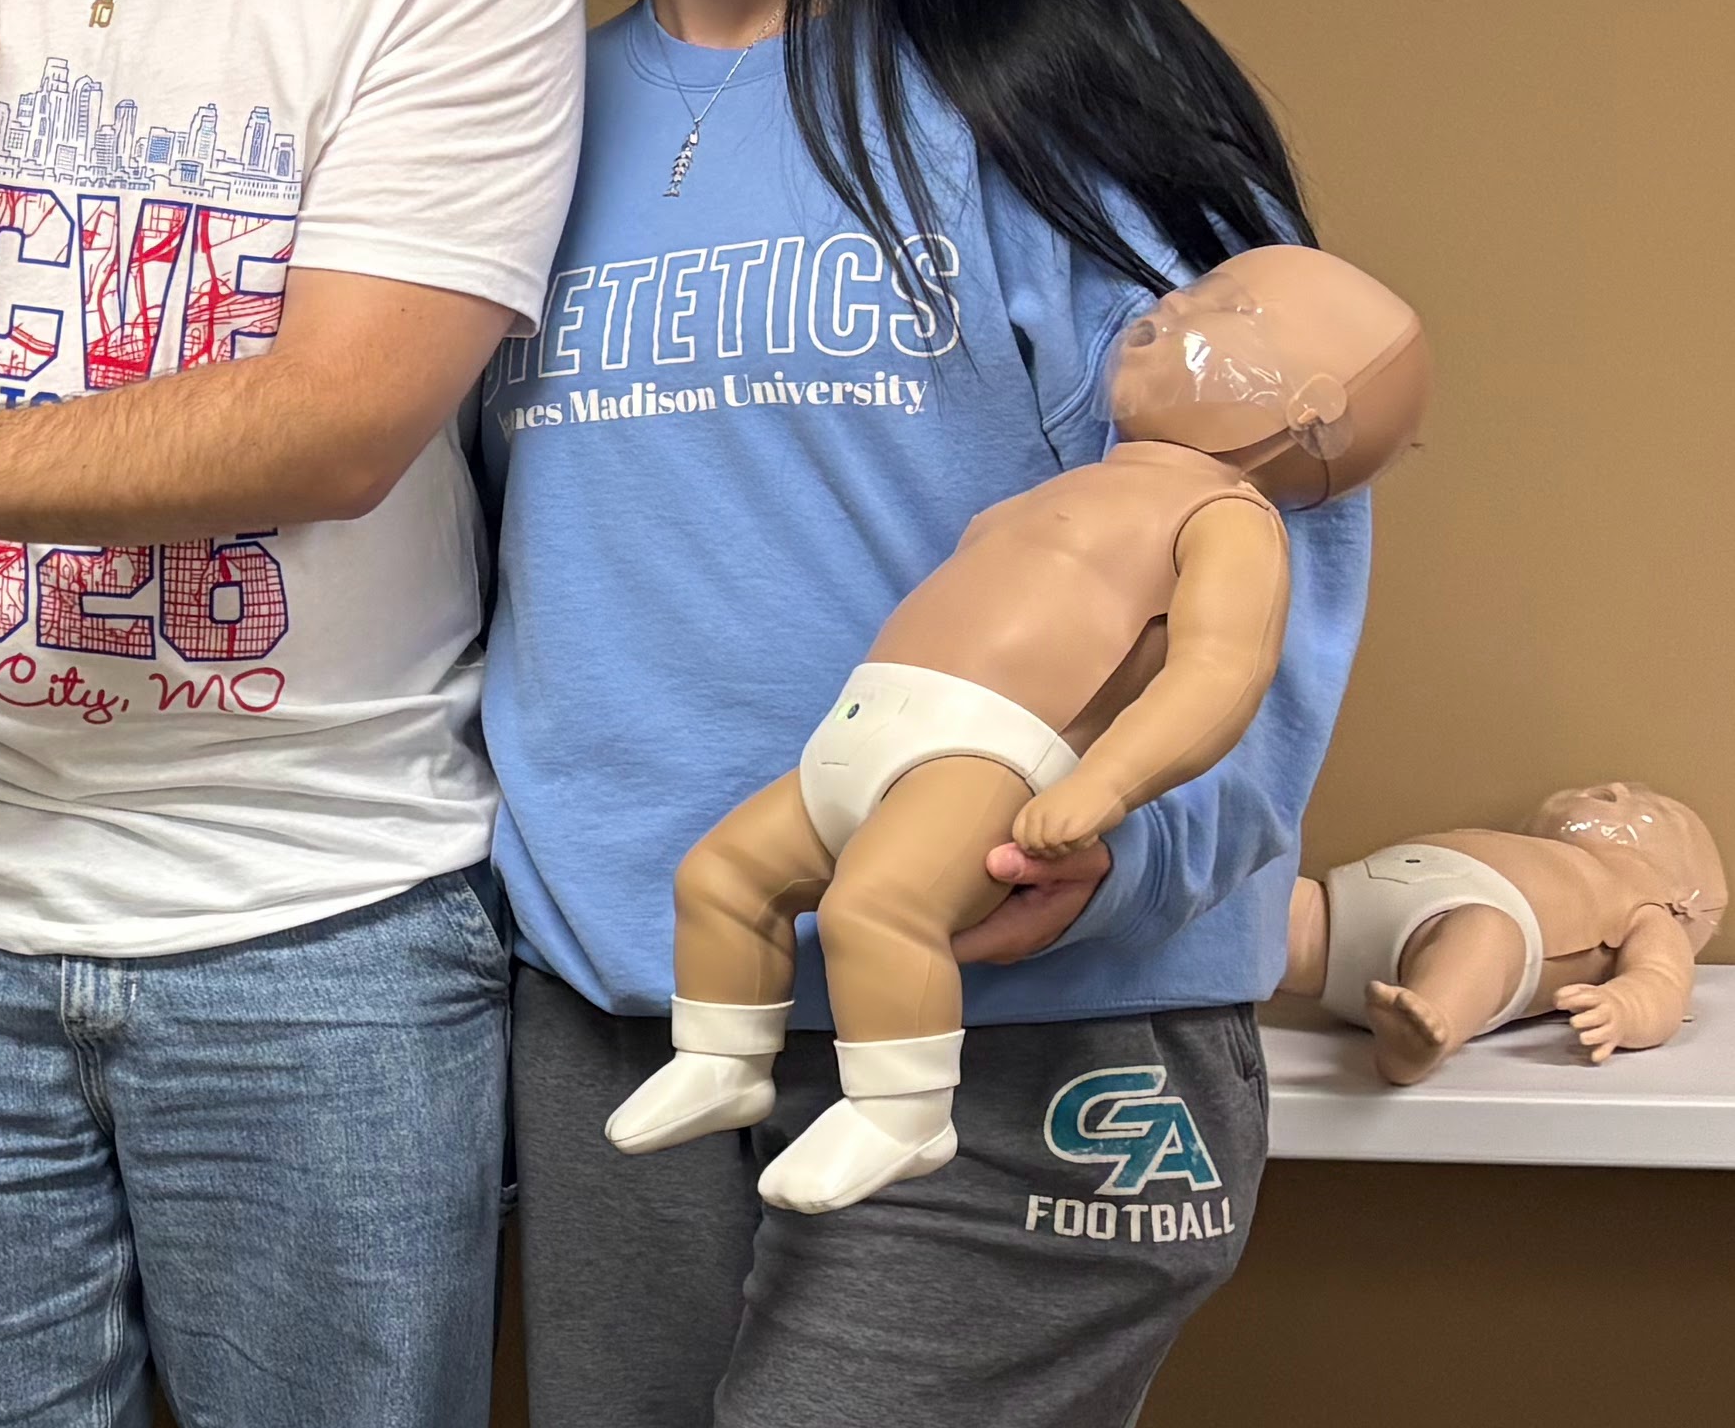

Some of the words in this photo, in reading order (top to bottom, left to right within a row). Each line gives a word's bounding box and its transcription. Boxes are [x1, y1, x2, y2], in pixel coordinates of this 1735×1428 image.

[484, 232, 961, 406] ETETICS
[569, 381, 717, 426] Madison
[724, 371, 928, 415] University
[149, 667, 286, 712] MO
[1025, 1194, 1236, 1243] FOOTBALL
